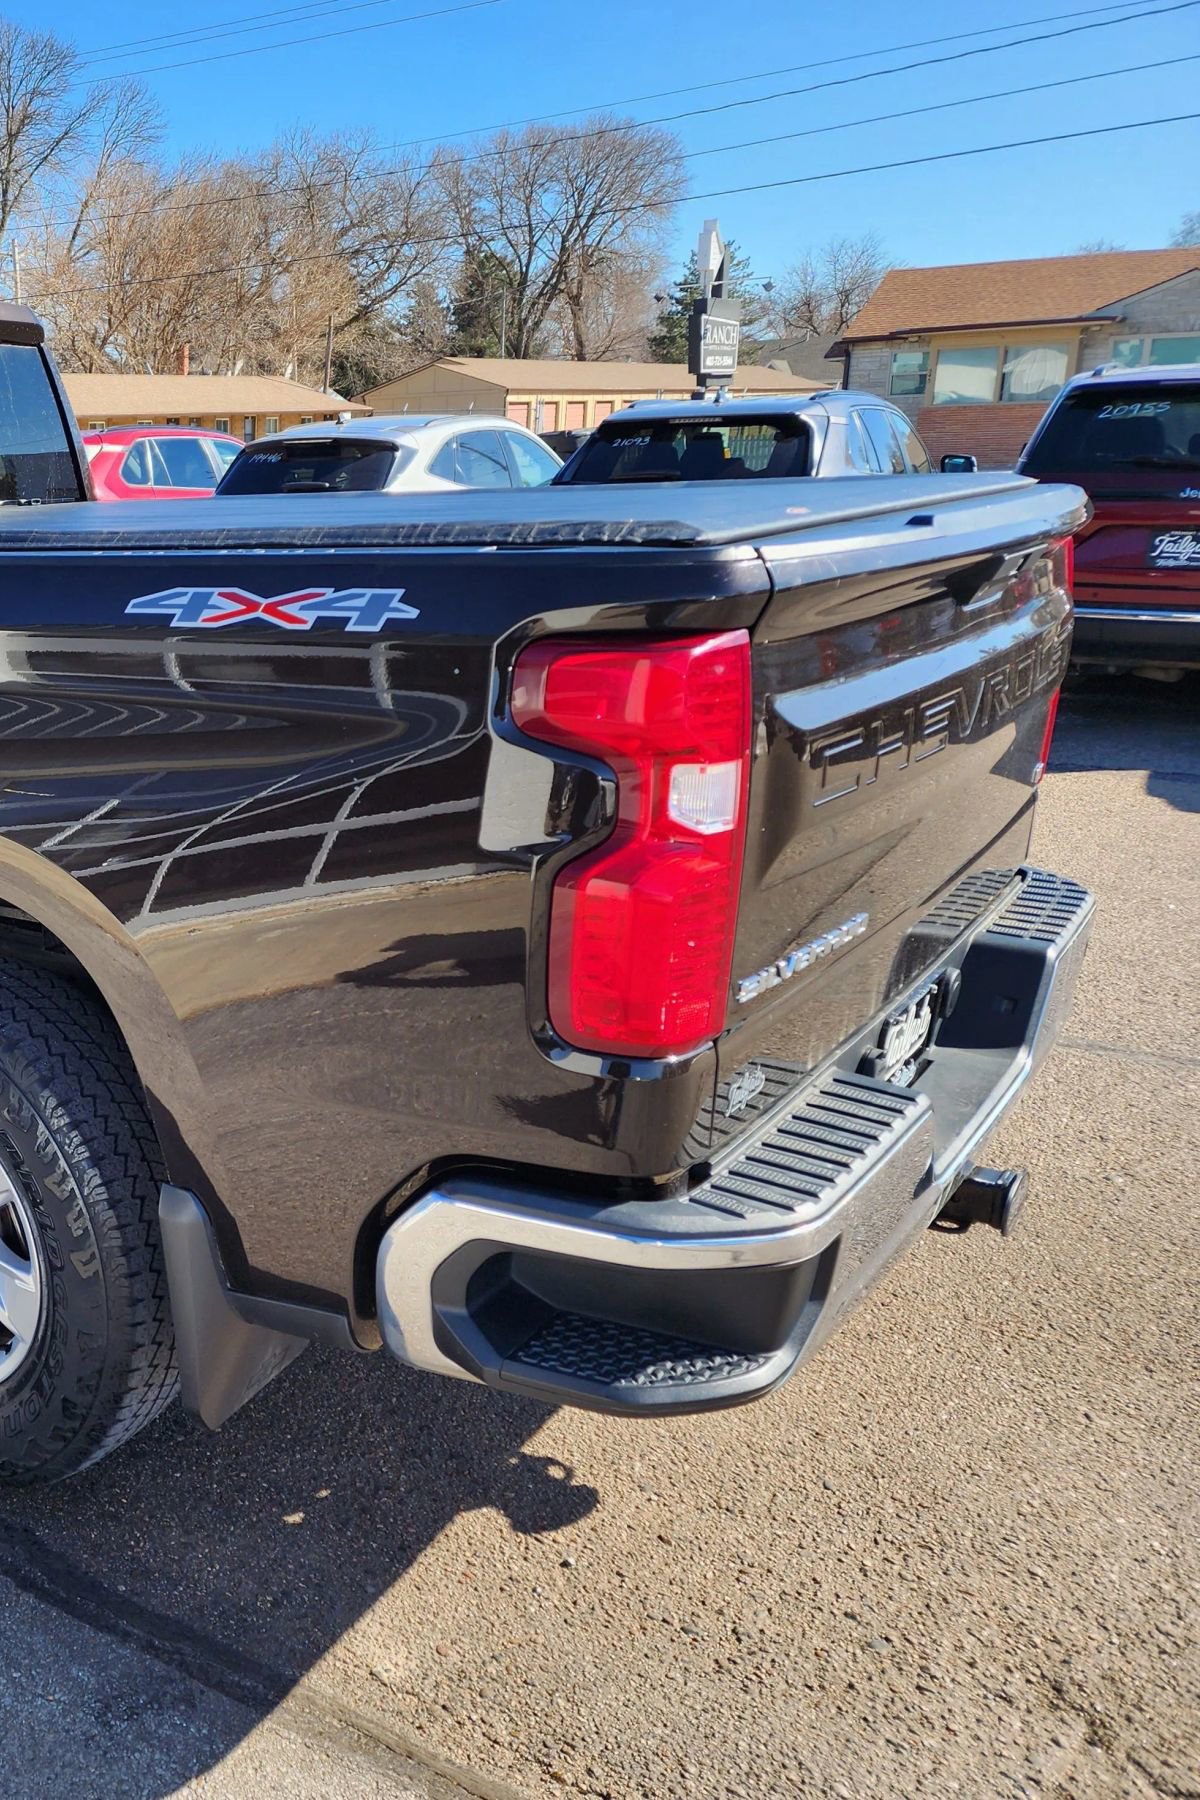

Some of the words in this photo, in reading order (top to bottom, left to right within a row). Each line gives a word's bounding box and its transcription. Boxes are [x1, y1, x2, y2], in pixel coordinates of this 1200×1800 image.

[705, 323, 738, 345] RANCH
[1098, 401, 1172, 419] 20955
[611, 435, 651, 448] 21093
[1179, 486, 1200, 498] Je
[736, 912, 870, 1004] SILVERADO
